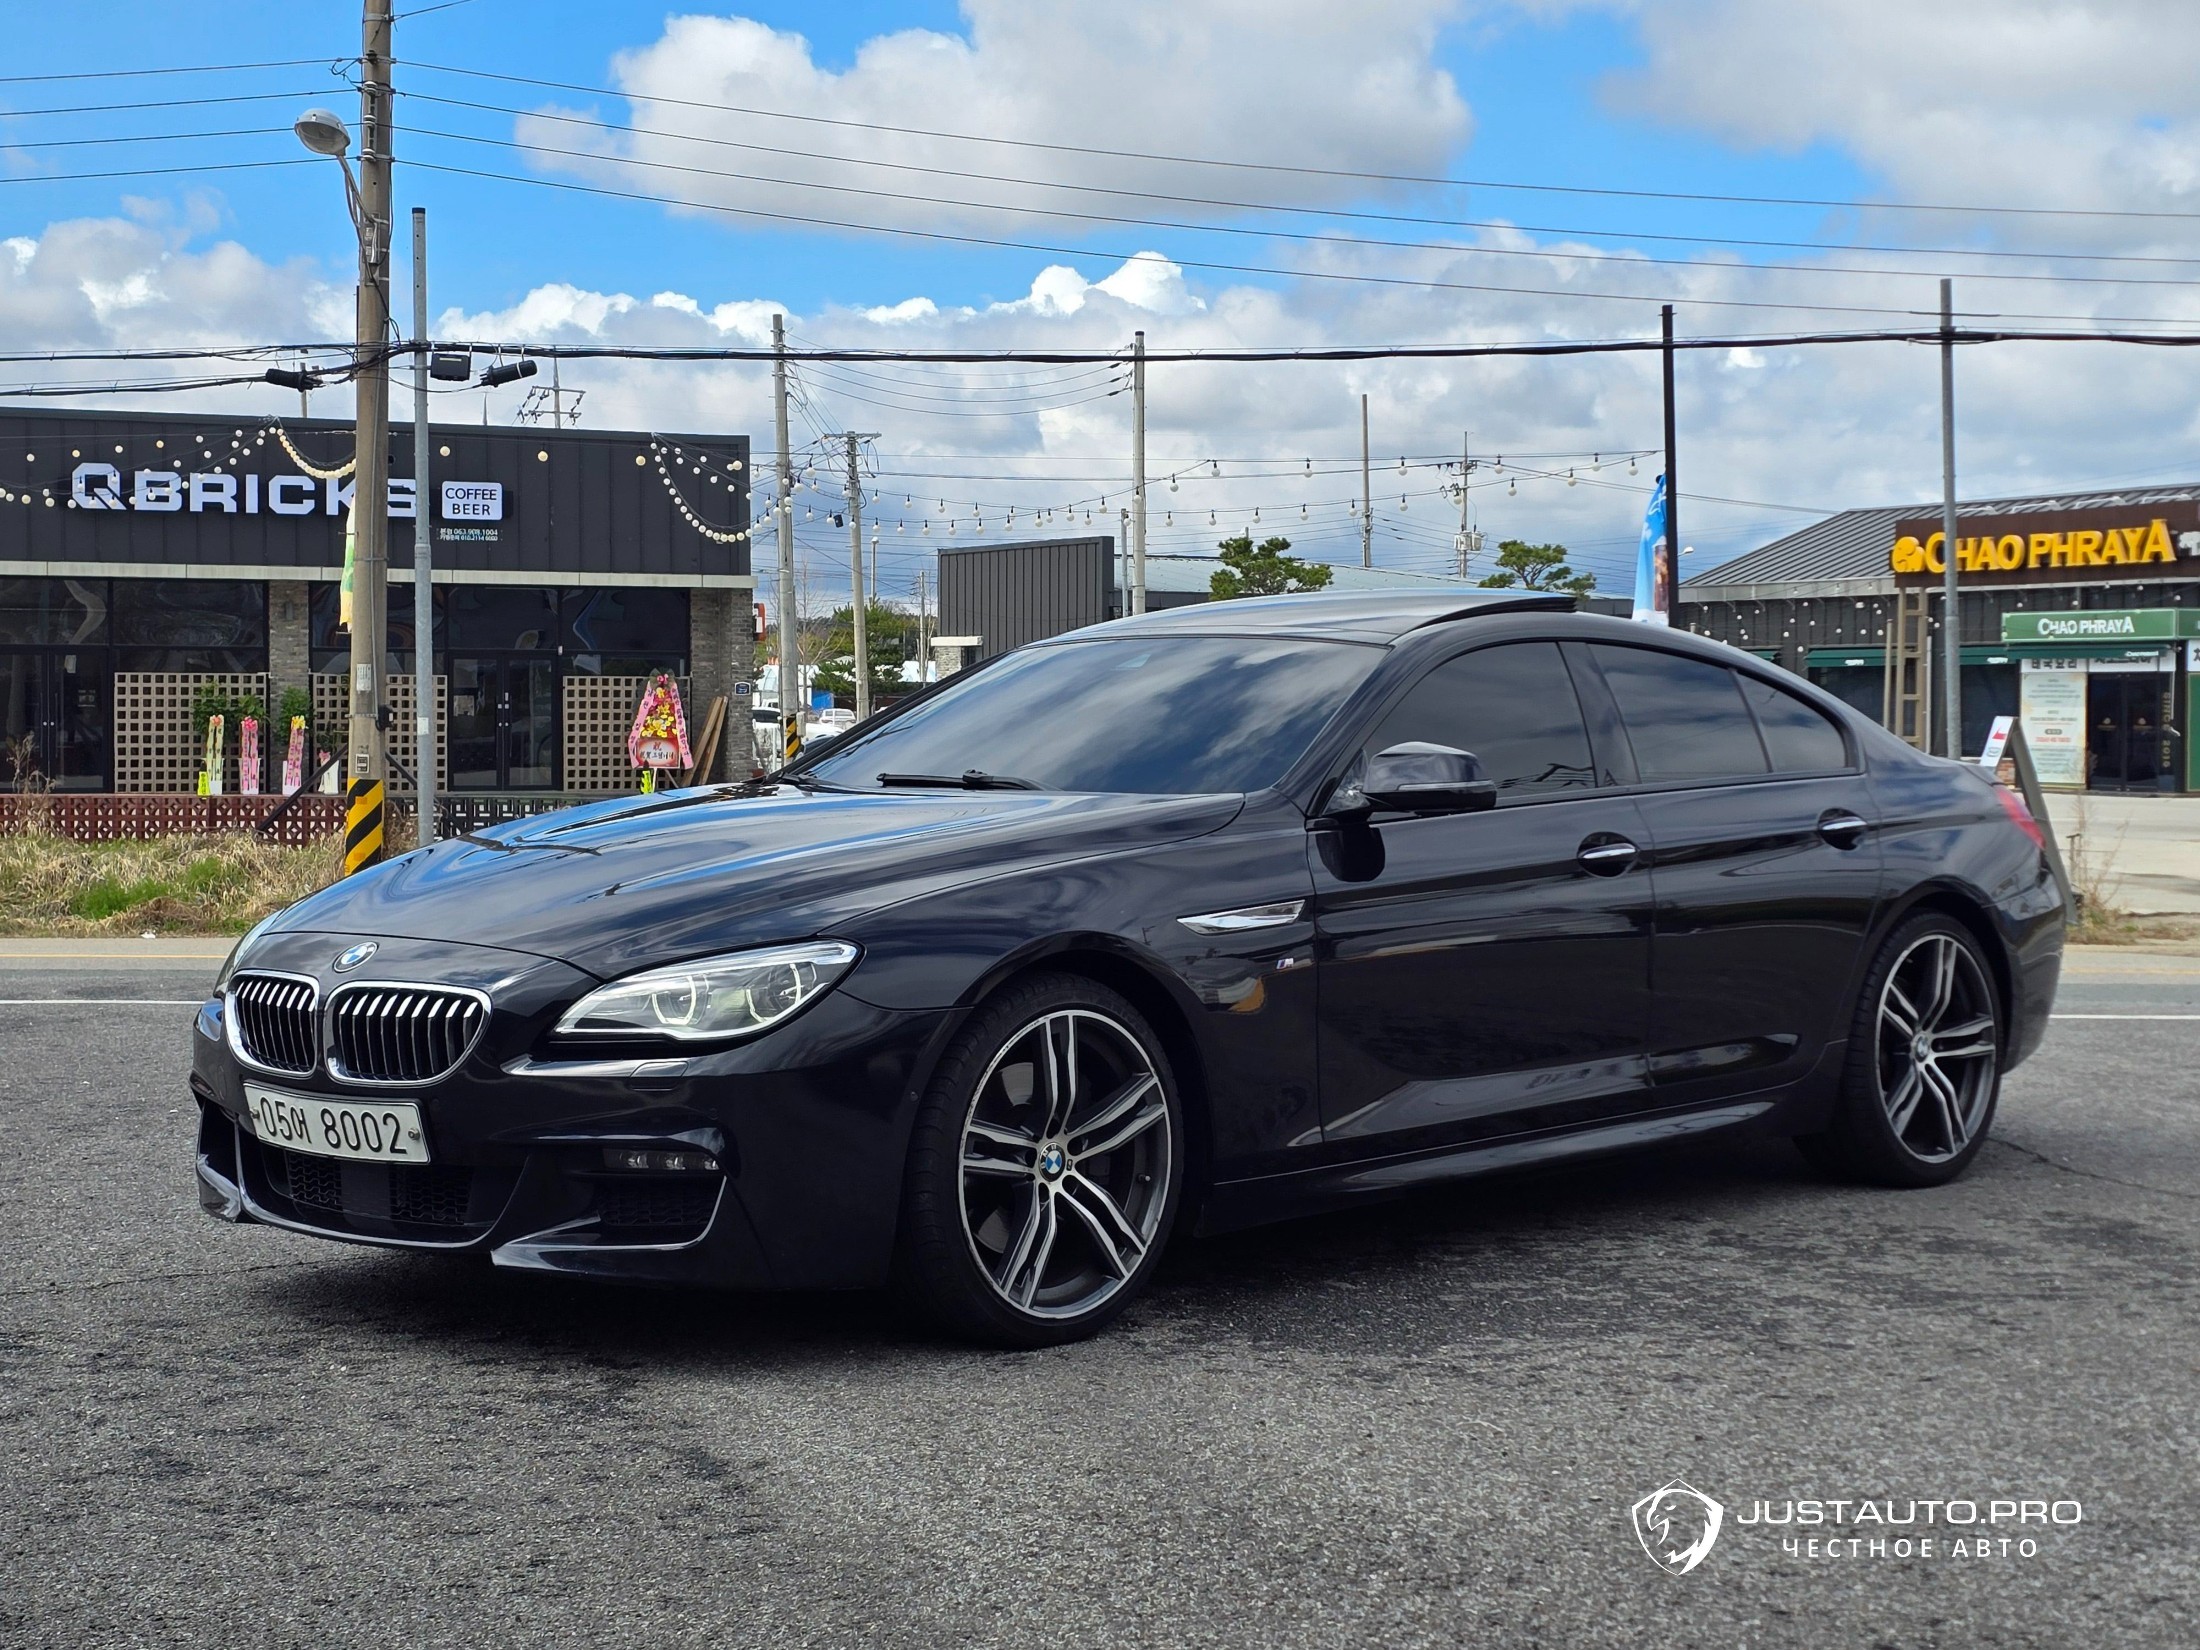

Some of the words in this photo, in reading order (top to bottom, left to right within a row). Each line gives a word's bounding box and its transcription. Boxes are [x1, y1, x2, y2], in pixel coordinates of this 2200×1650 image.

[445, 487, 497, 501] COFFEE
[452, 503, 491, 516] BEER
[1925, 531, 2025, 574] CHAO
[2027, 518, 2177, 569] PHRAYA
[2038, 617, 2077, 635] CHAO
[2079, 616, 2135, 634] PHRAYA
[260, 1097, 313, 1144] 05어
[320, 1107, 408, 1155] 8002
